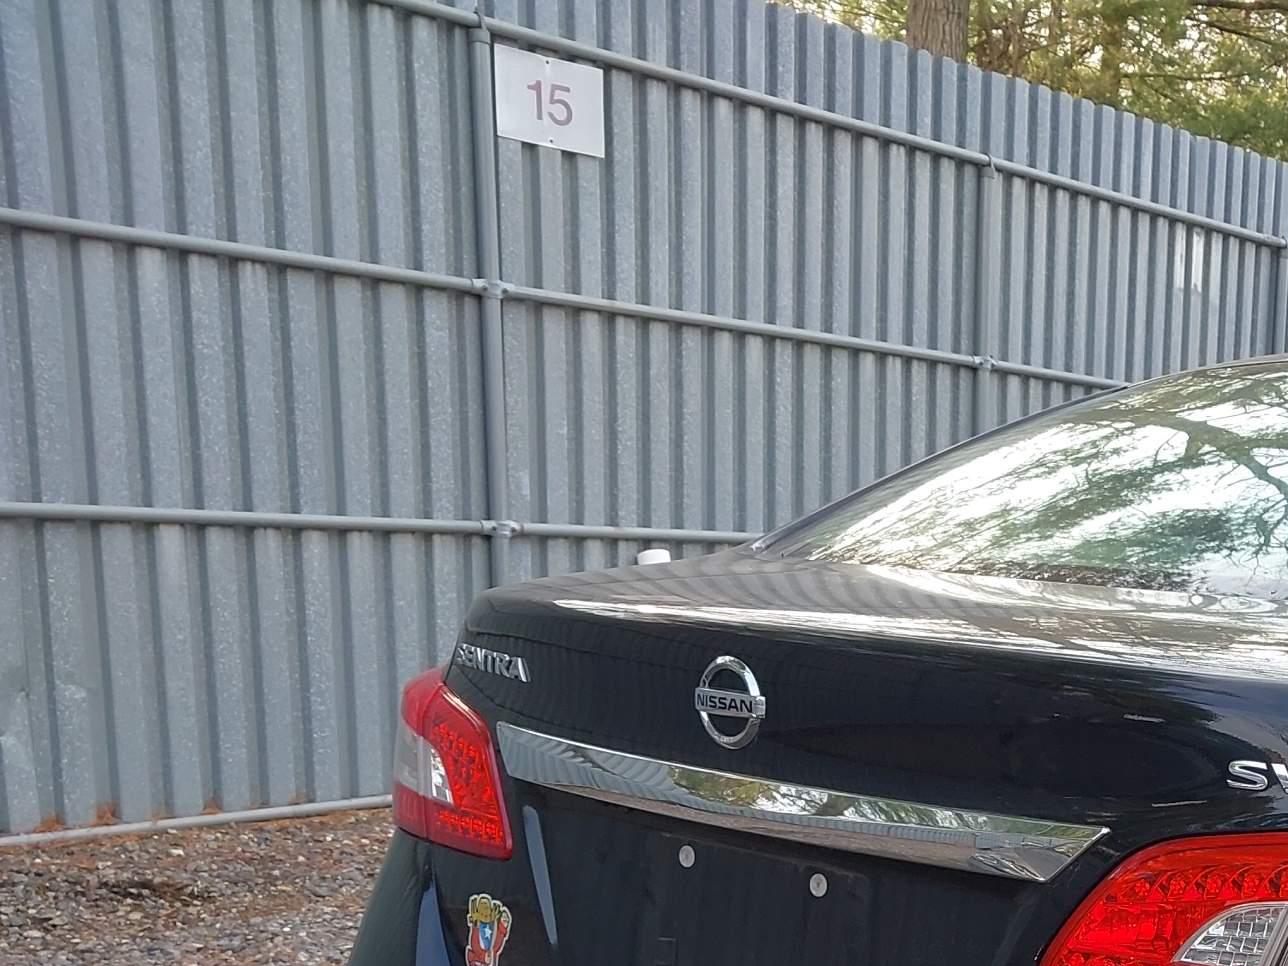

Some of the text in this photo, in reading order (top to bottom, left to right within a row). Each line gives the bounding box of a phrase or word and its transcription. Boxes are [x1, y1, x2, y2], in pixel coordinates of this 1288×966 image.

[527, 79, 573, 127] 15
[456, 642, 532, 683] SENTRA
[696, 693, 754, 713] NISSAN
